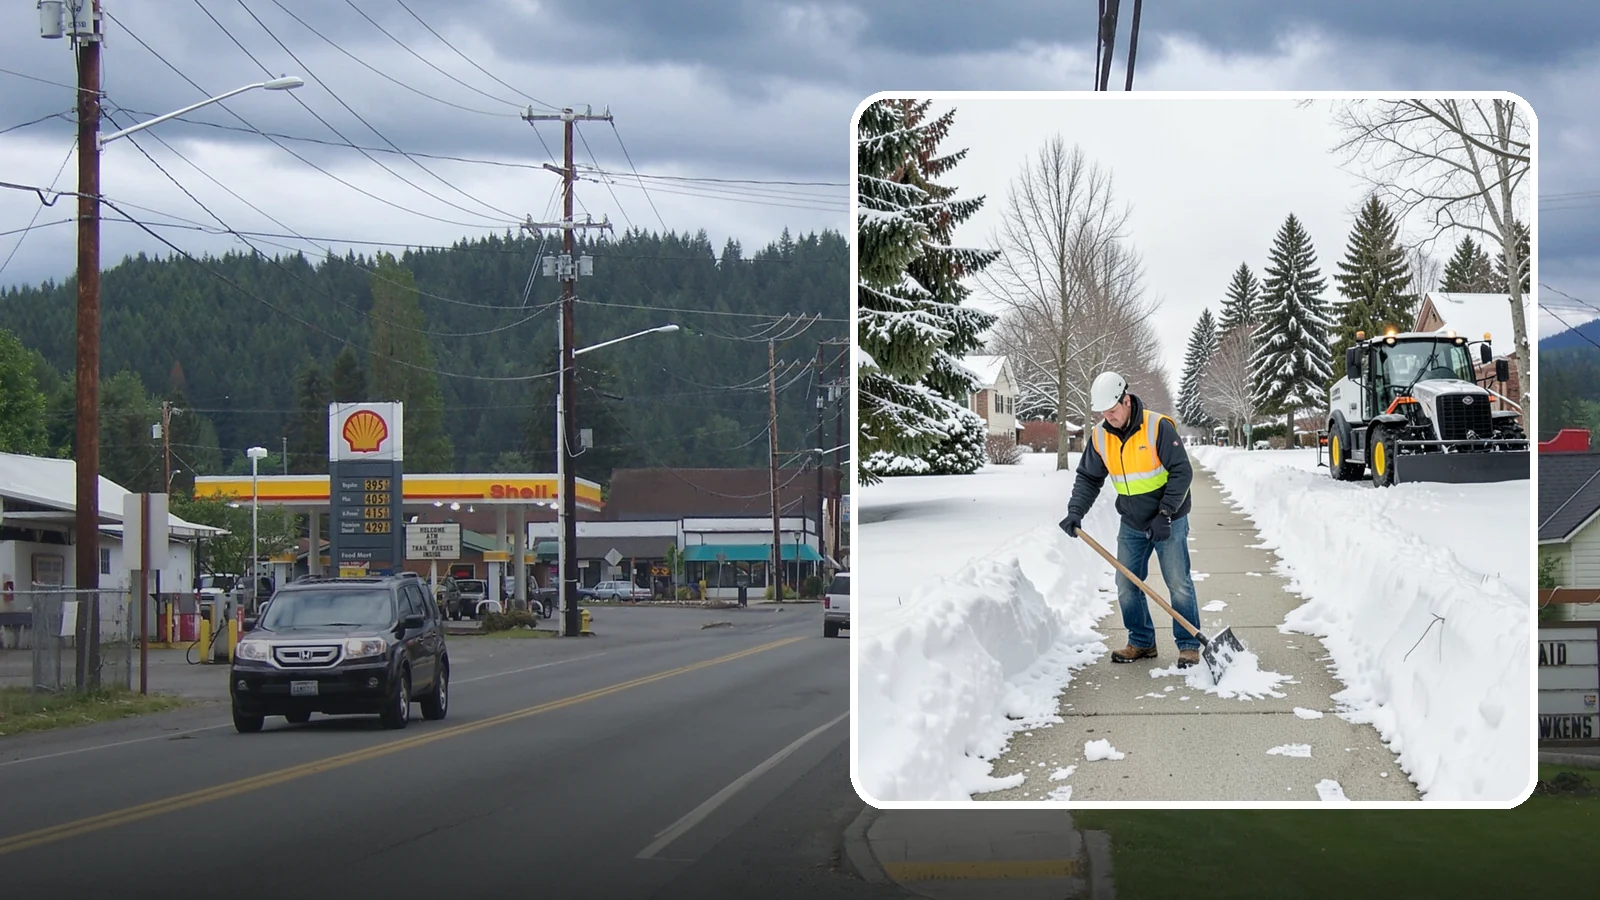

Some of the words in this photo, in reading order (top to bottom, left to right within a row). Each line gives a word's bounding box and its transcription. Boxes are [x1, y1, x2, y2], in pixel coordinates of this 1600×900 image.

[366, 480, 383, 490] 395
[490, 484, 547, 499] Shell
[366, 494, 383, 504] 405
[366, 508, 383, 518] 415
[366, 522, 383, 532] 429
